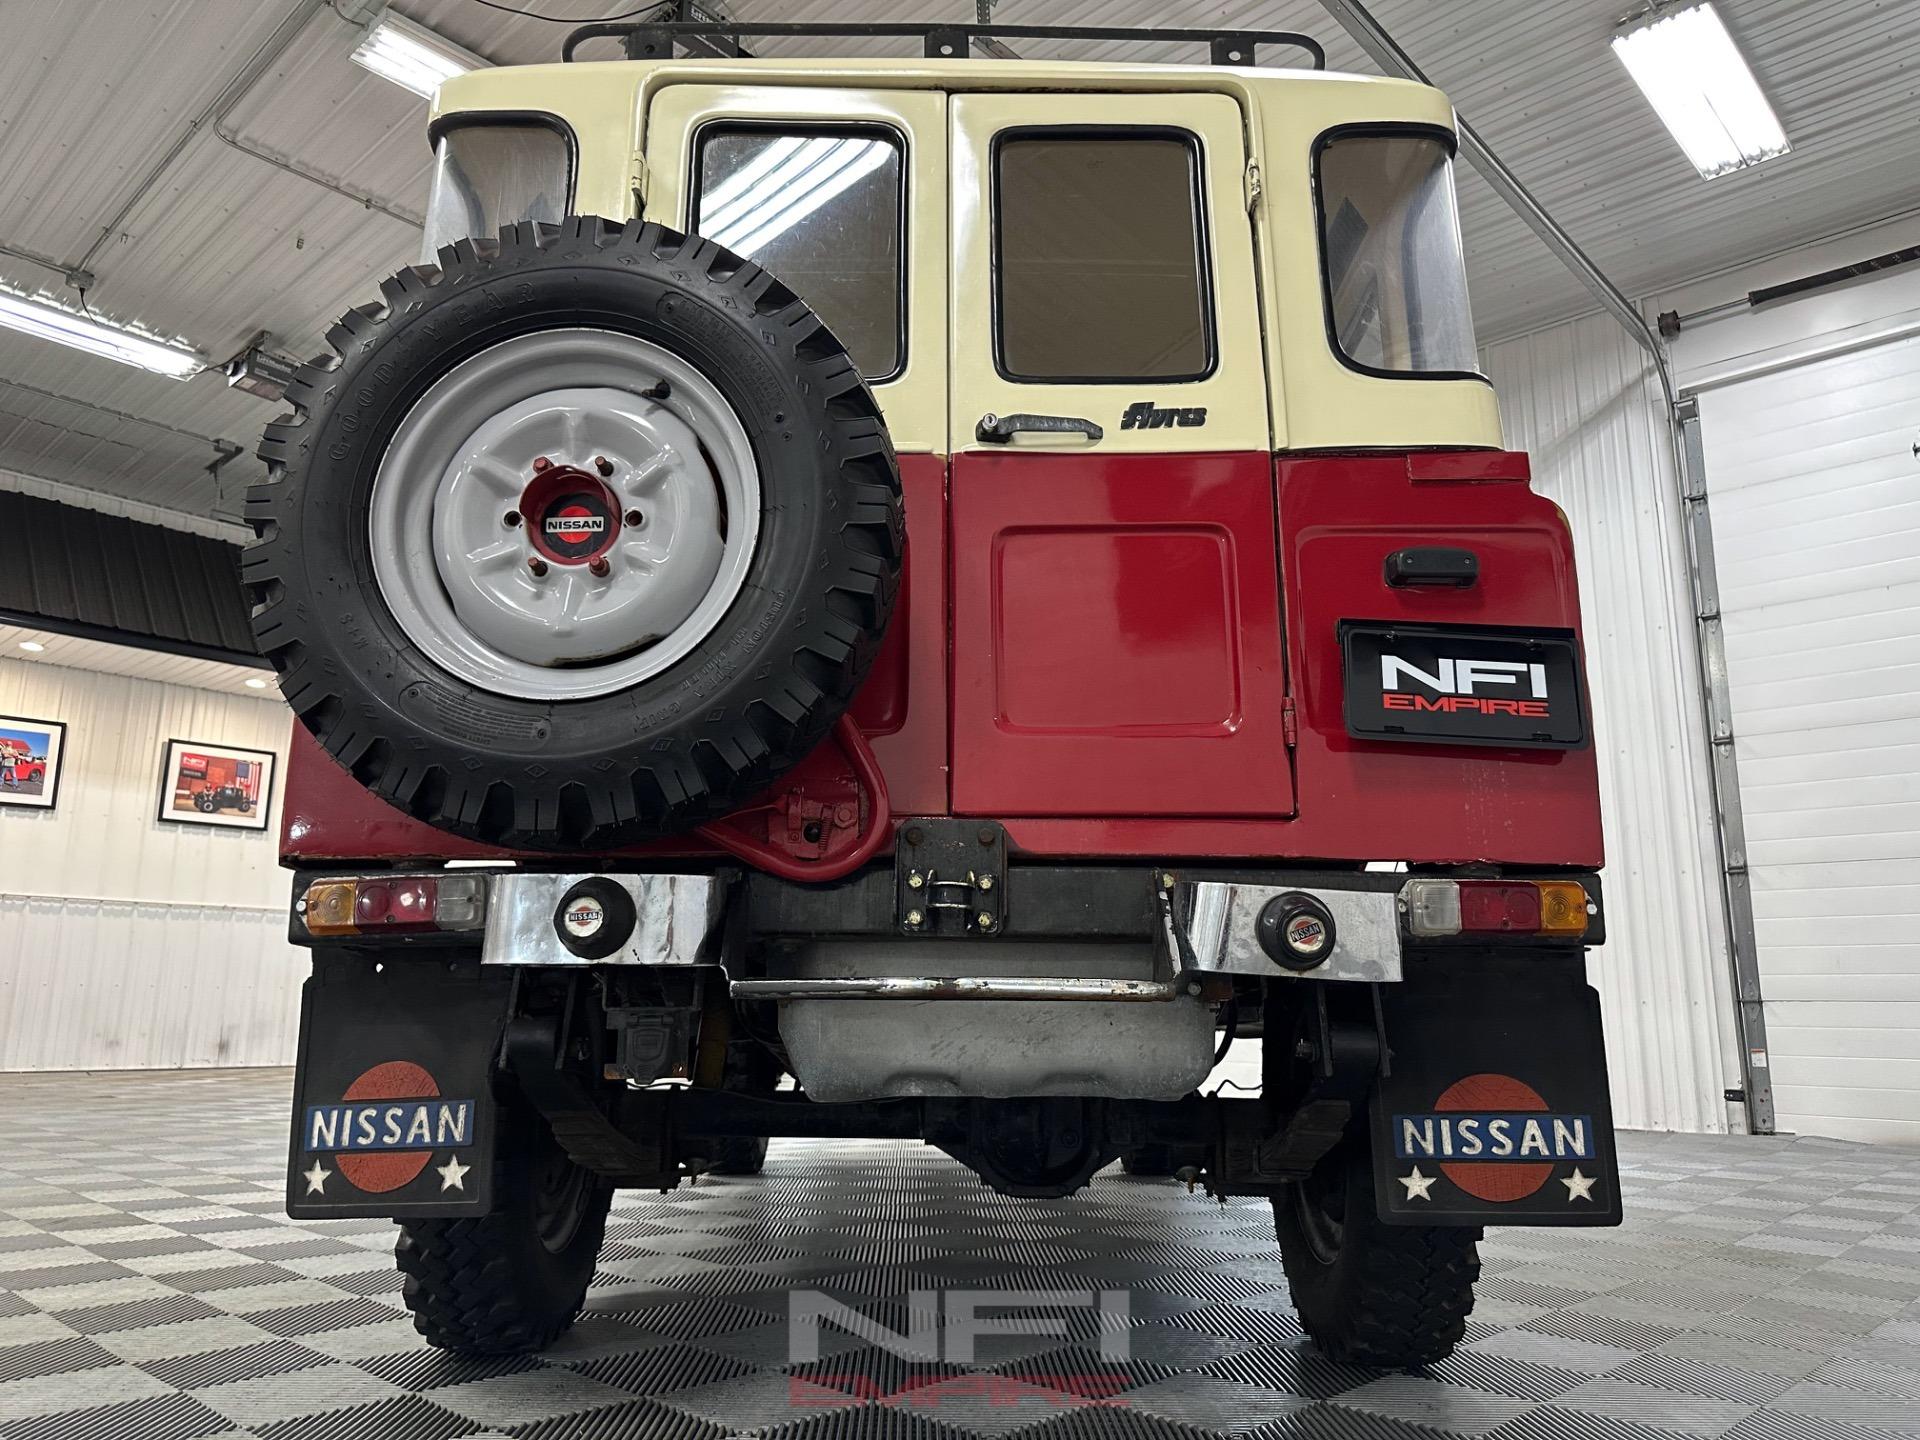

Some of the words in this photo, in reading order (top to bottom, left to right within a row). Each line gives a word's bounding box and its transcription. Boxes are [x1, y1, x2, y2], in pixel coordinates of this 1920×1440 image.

[547, 520, 602, 530] NISSAN
[1381, 654, 1548, 699] NFI
[1382, 693, 1550, 718] EMPIRE
[570, 912, 599, 921] NISSAN
[1290, 923, 1321, 942] NISSAN
[311, 1103, 467, 1148] NISSAN
[1402, 1118, 1586, 1157] NISSAN
